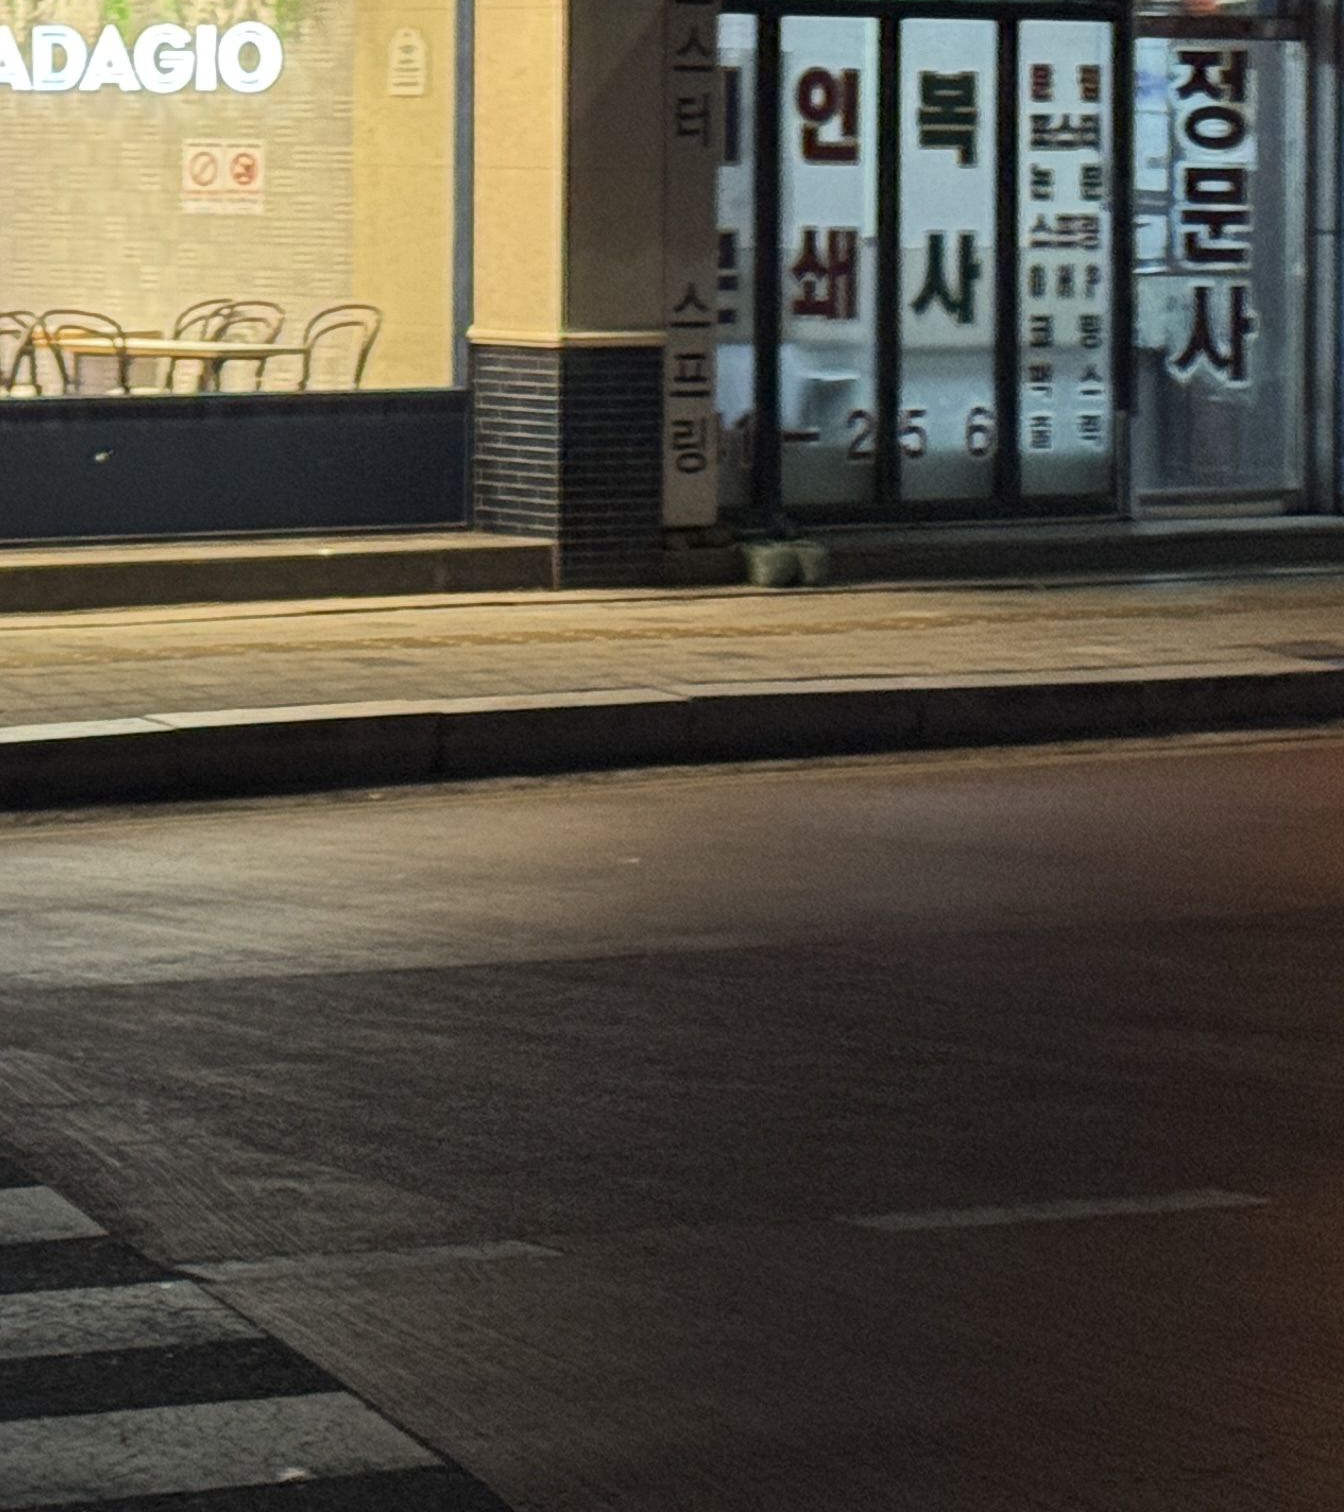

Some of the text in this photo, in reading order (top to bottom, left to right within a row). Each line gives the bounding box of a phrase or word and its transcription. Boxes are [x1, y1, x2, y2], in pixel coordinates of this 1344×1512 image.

[792, 65, 862, 322] 인쇄
[912, 69, 983, 324] 복사
[1169, 47, 1258, 386] 정문사
[669, 280, 713, 478] 스프링
